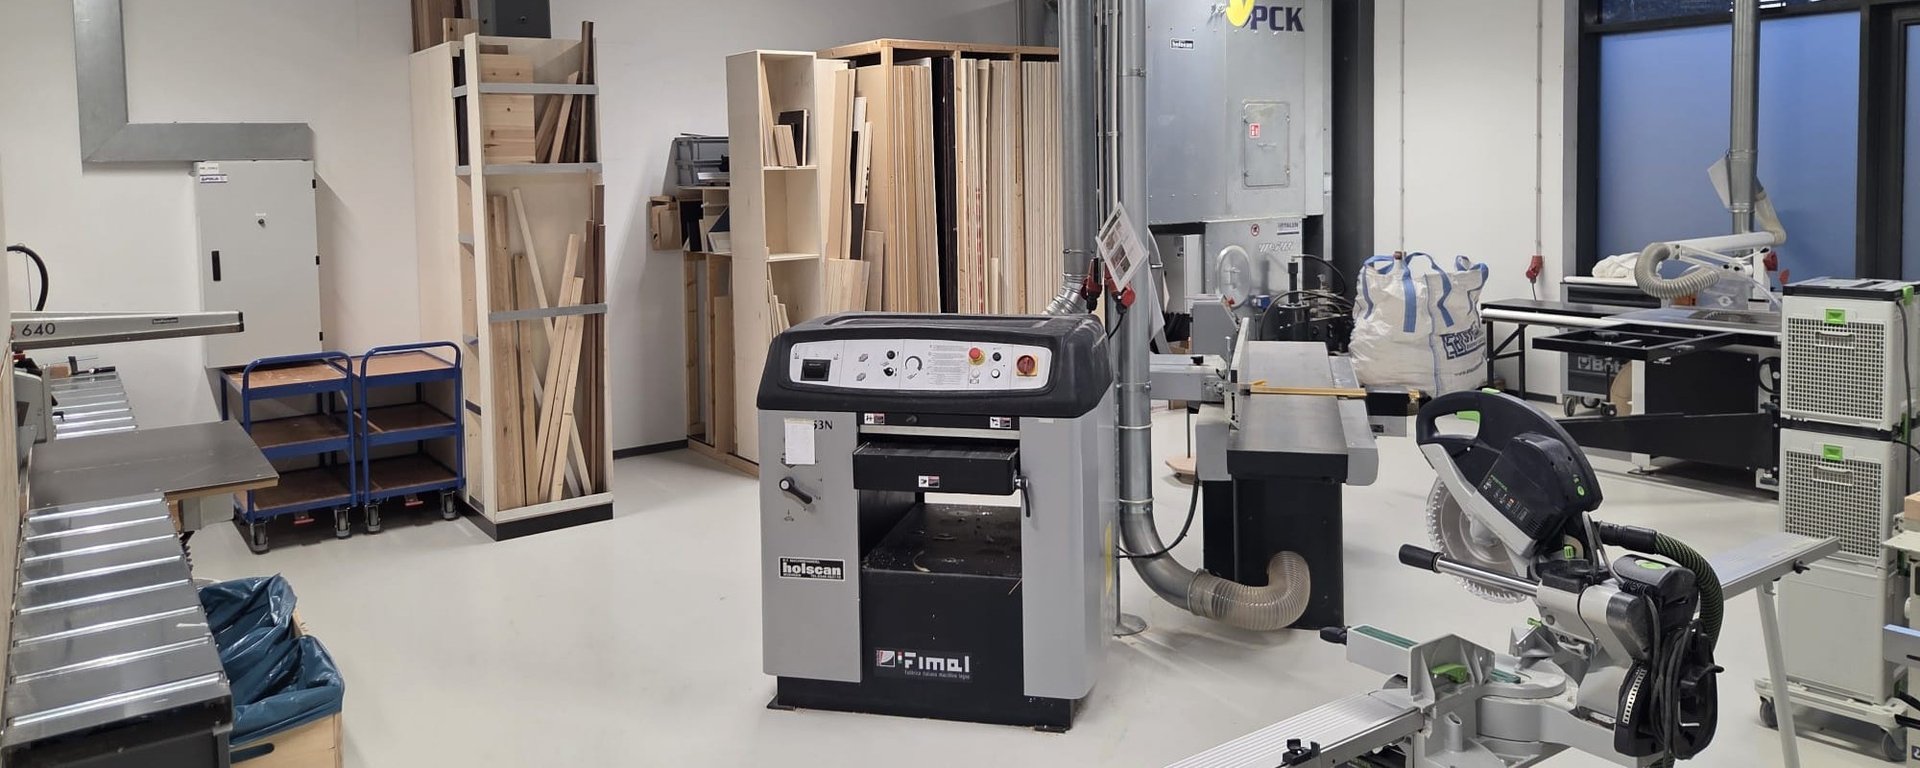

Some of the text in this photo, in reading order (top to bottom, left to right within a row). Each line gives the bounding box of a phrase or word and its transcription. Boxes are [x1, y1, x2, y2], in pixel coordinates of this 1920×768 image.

[1250, 6, 1304, 32] PCK
[22, 323, 56, 336] 640
[783, 562, 841, 576] holscan
[904, 652, 970, 672] Fimal
